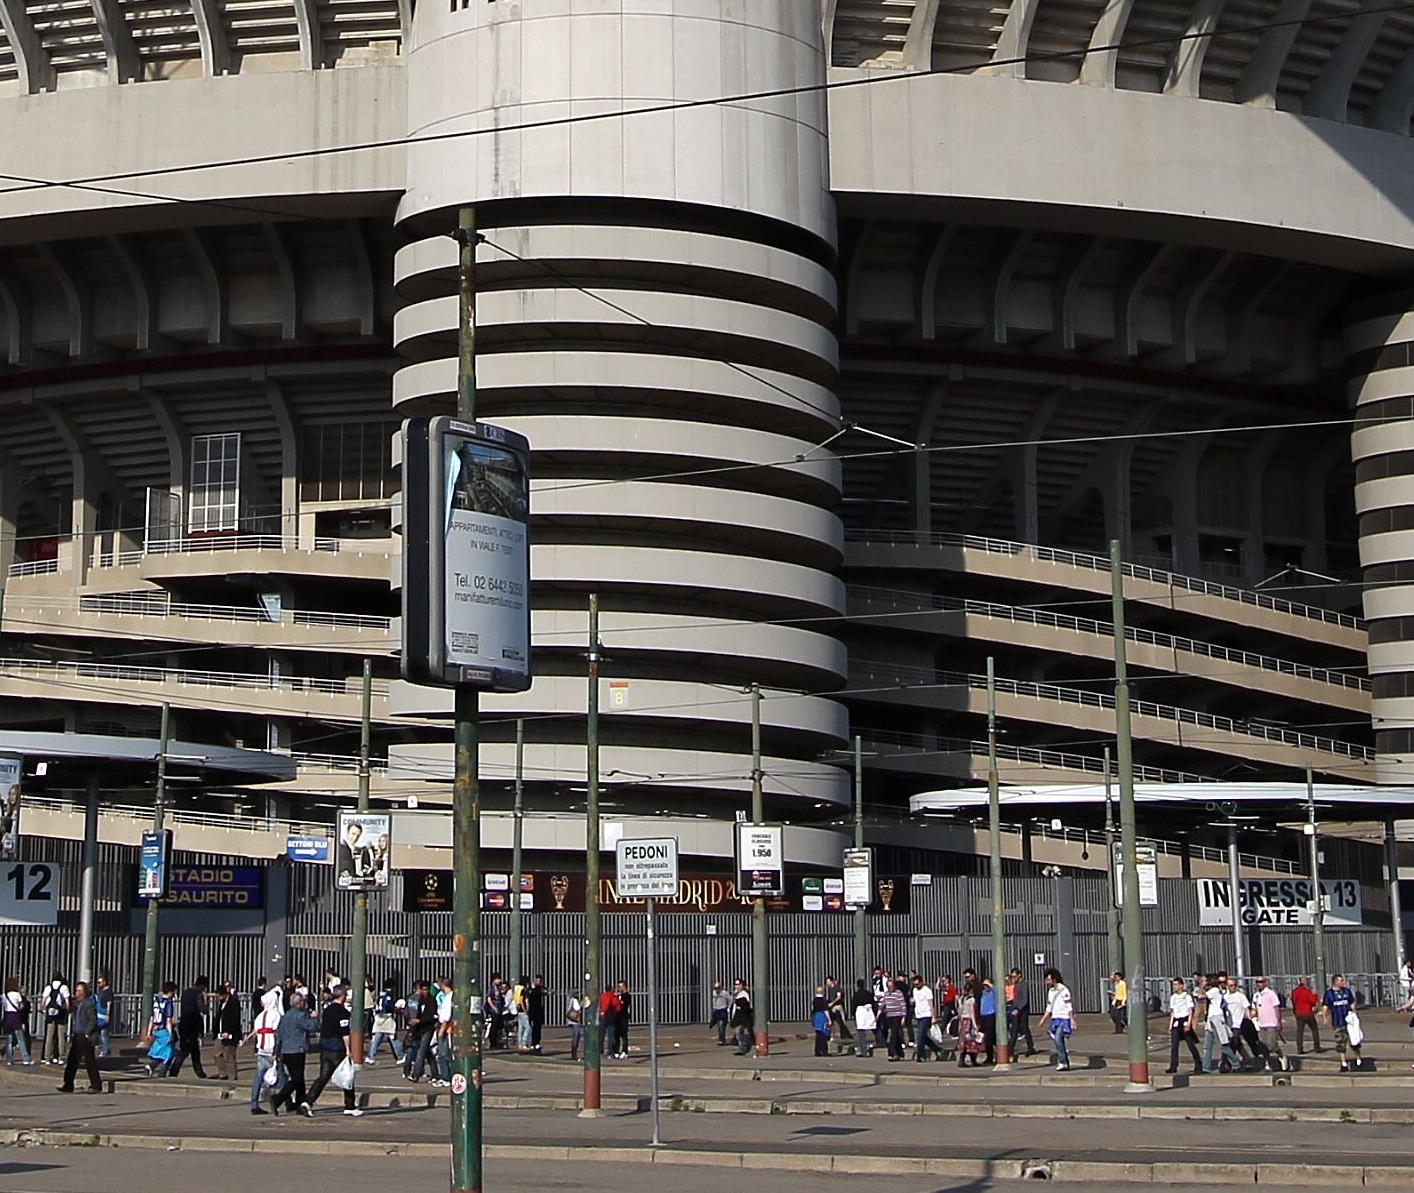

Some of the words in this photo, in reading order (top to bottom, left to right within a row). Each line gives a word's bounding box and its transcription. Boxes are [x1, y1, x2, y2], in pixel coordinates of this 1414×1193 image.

[454, 572, 470, 588] Tel.
[474, 575, 485, 590] 02
[625, 845, 668, 859] PEDONI
[6, 863, 52, 901] 12
[159, 890, 249, 904] SAURITO
[1334, 881, 1357, 907] 13
[1242, 909, 1299, 924] GATE
